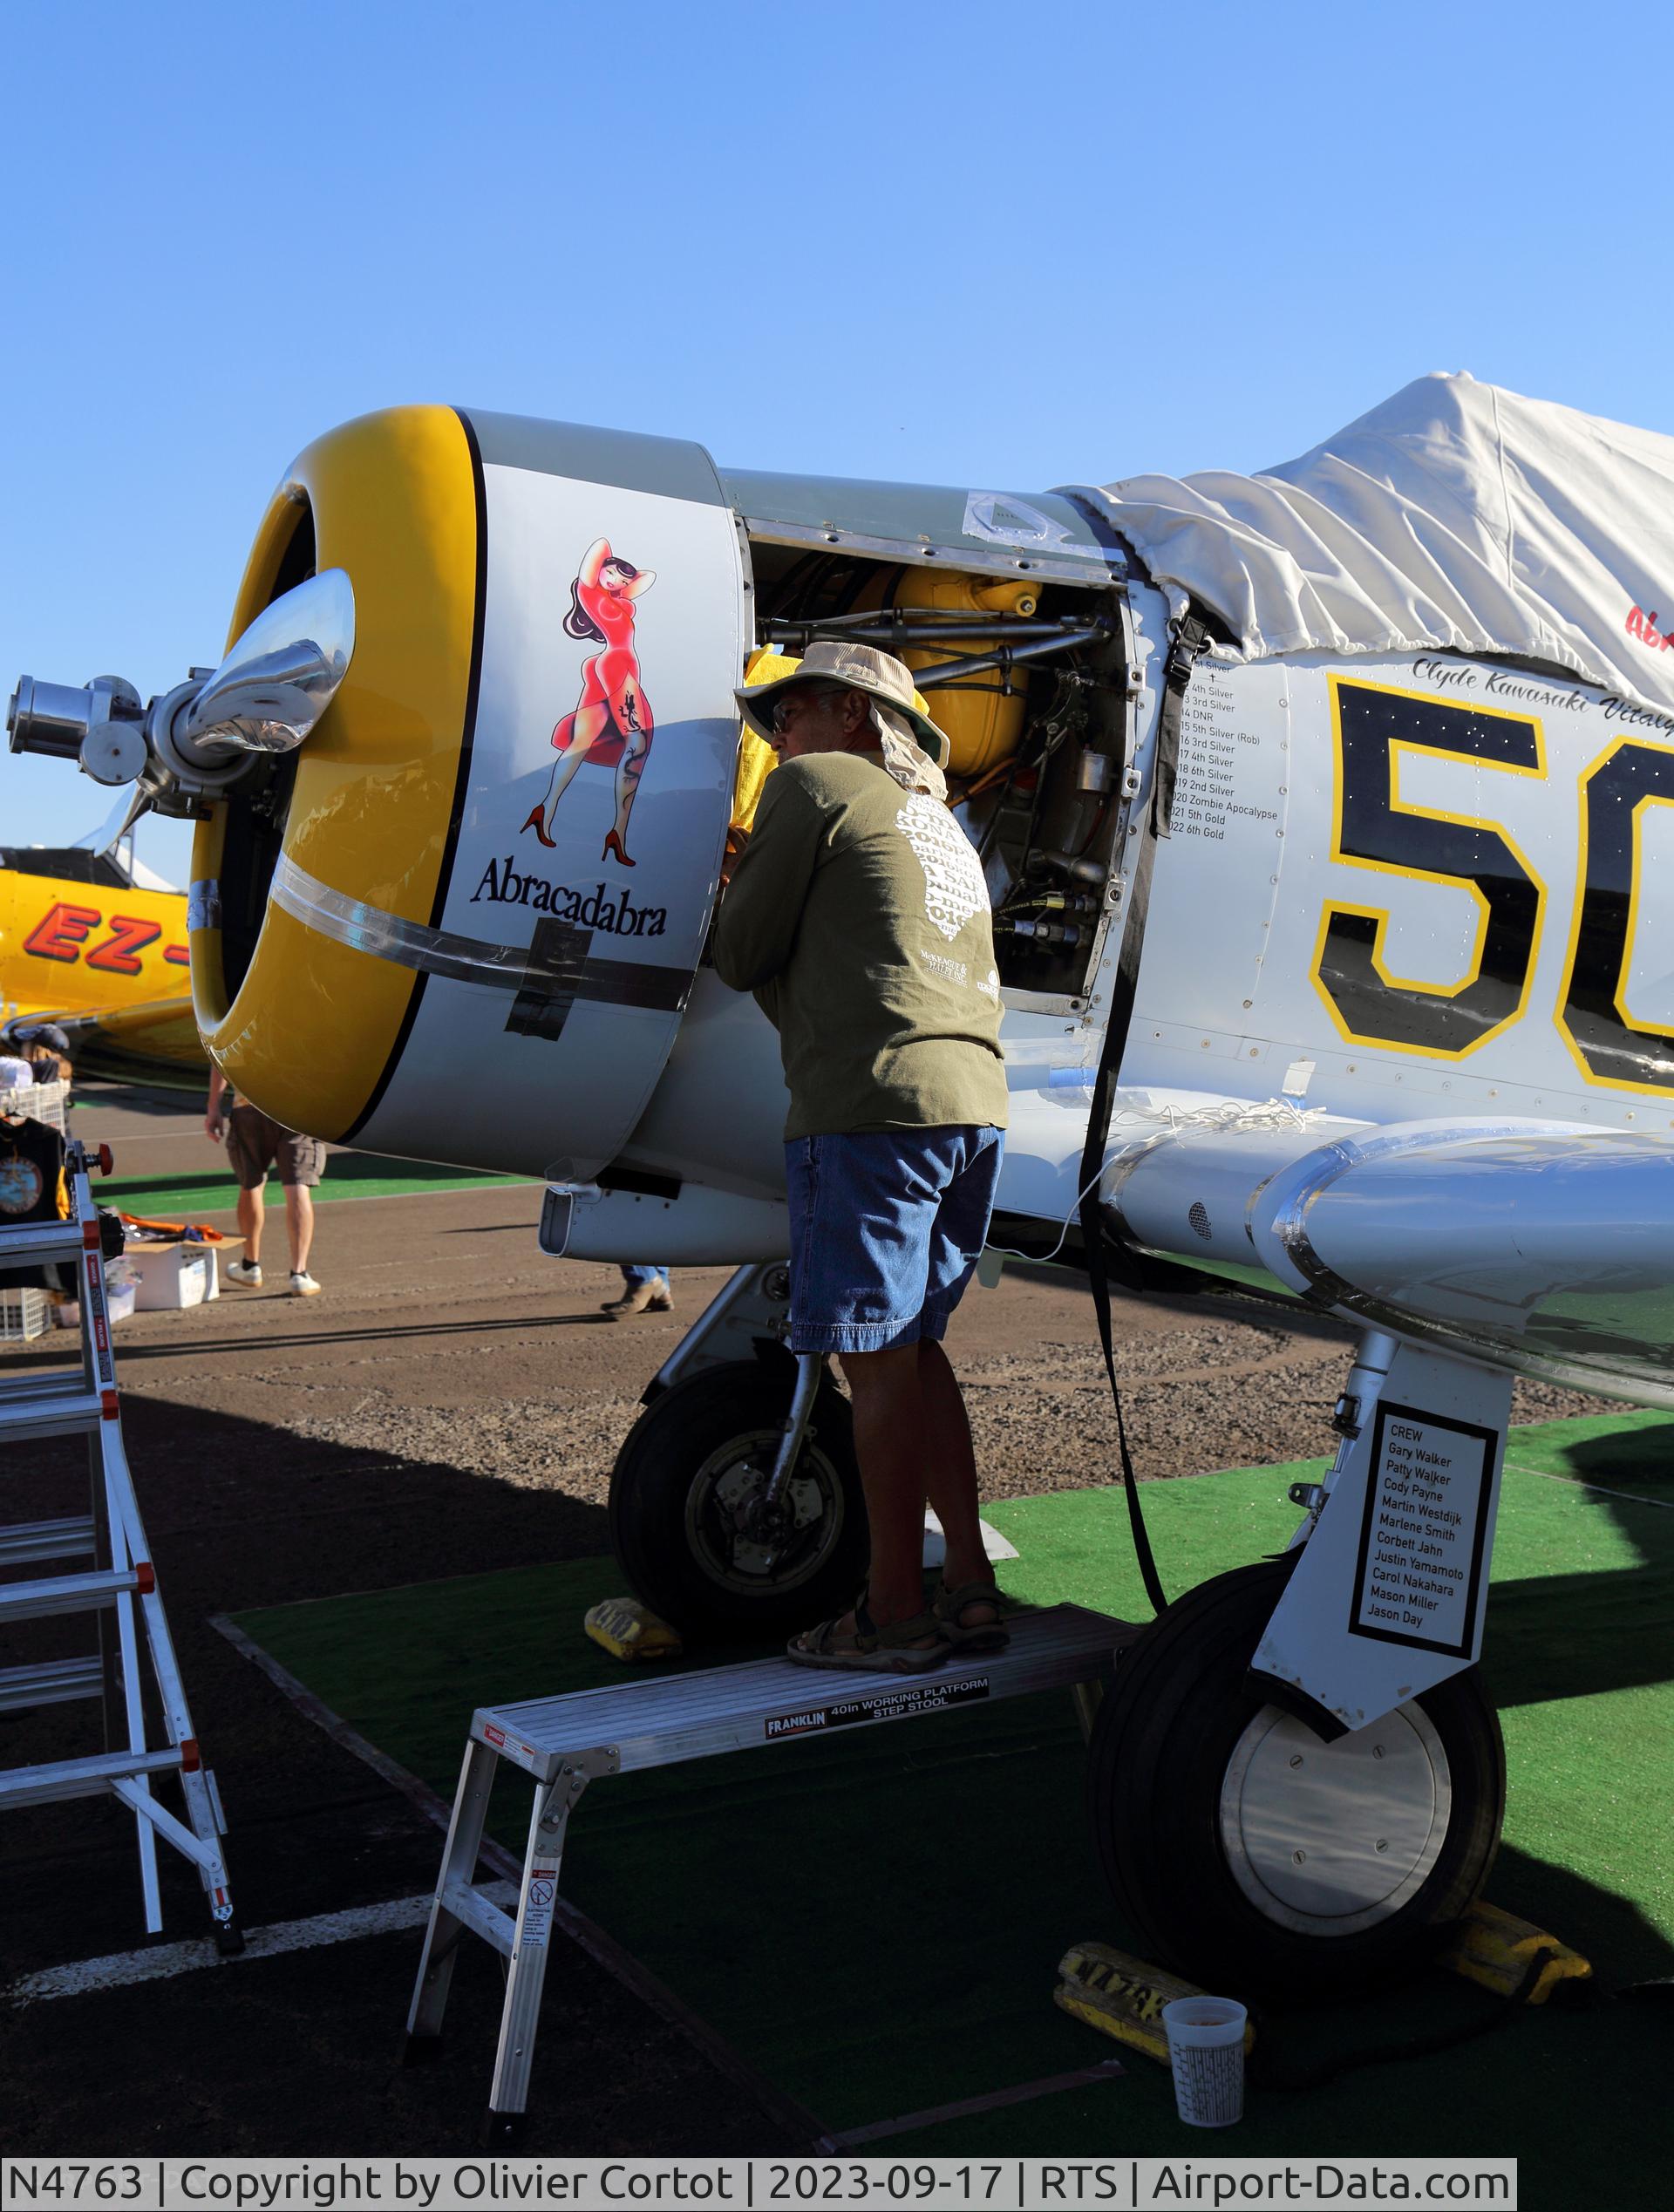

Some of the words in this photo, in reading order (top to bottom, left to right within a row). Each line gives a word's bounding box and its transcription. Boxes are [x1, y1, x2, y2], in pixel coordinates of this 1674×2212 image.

[1207, 662, 1230, 674] Silver
[1192, 684, 1206, 694] 4th
[1208, 687, 1234, 699] Silver
[1412, 658, 1479, 689] Clyde
[1485, 671, 1590, 713] Kawasaki
[1193, 697, 1208, 707] 3rd
[1210, 700, 1235, 712] Silver
[1193, 710, 1213, 722] DNR
[1192, 738, 1208, 748] 3rd
[1210, 740, 1235, 753] Silver
[1193, 724, 1206, 734] 5th
[1209, 727, 1235, 739] Silver
[1237, 732, 1260, 745] (Rob)
[1191, 752, 1206, 762] 4th
[1208, 755, 1234, 767] Silver
[1191, 766, 1205, 777] 6th
[1208, 769, 1234, 781] Silver
[1190, 780, 1207, 792] 2nd
[1209, 784, 1235, 796] Silver
[1187, 810, 1202, 820] 5th
[1205, 813, 1226, 825] Gold
[1189, 795, 1224, 809] Zombie
[1226, 802, 1278, 820] Apocalypse
[1187, 824, 1201, 835] 6th
[1203, 827, 1224, 840] Gold
[469, 855, 667, 936] Abracadabra
[1391, 1425, 1423, 1442] CREW
[1388, 1442, 1412, 1460] Gary
[1416, 1449, 1452, 1468] Walker
[1386, 1460, 1412, 1478] Patty
[1415, 1467, 1451, 1487] Walker
[1384, 1477, 1409, 1495] Cody
[1412, 1484, 1443, 1502] Payne
[1382, 1494, 1415, 1514] Martin
[1418, 1502, 1461, 1526] Westdijk
[1379, 1513, 1422, 1534] Marlene
[1425, 1524, 1455, 1542] Smith
[1377, 1531, 1415, 1551] Corbett
[1418, 1541, 1443, 1557] Jahn
[1374, 1548, 1406, 1567] Justin
[1410, 1556, 1464, 1581] Yamamoto
[1372, 1567, 1400, 1585] Carol
[1403, 1573, 1454, 1596] Nakahara
[1371, 1584, 1405, 1604] Mason
[1408, 1592, 1439, 1611] Miller
[1367, 1603, 1399, 1622] Jason
[1402, 1610, 1423, 1629] Day
[861, 1691, 921, 1711] WORKING
[923, 1678, 989, 1698] PLATFORM
[873, 1705, 906, 1719] STEP
[908, 1697, 949, 1712] STOOL
[768, 1712, 826, 1736] FRANKLIN
